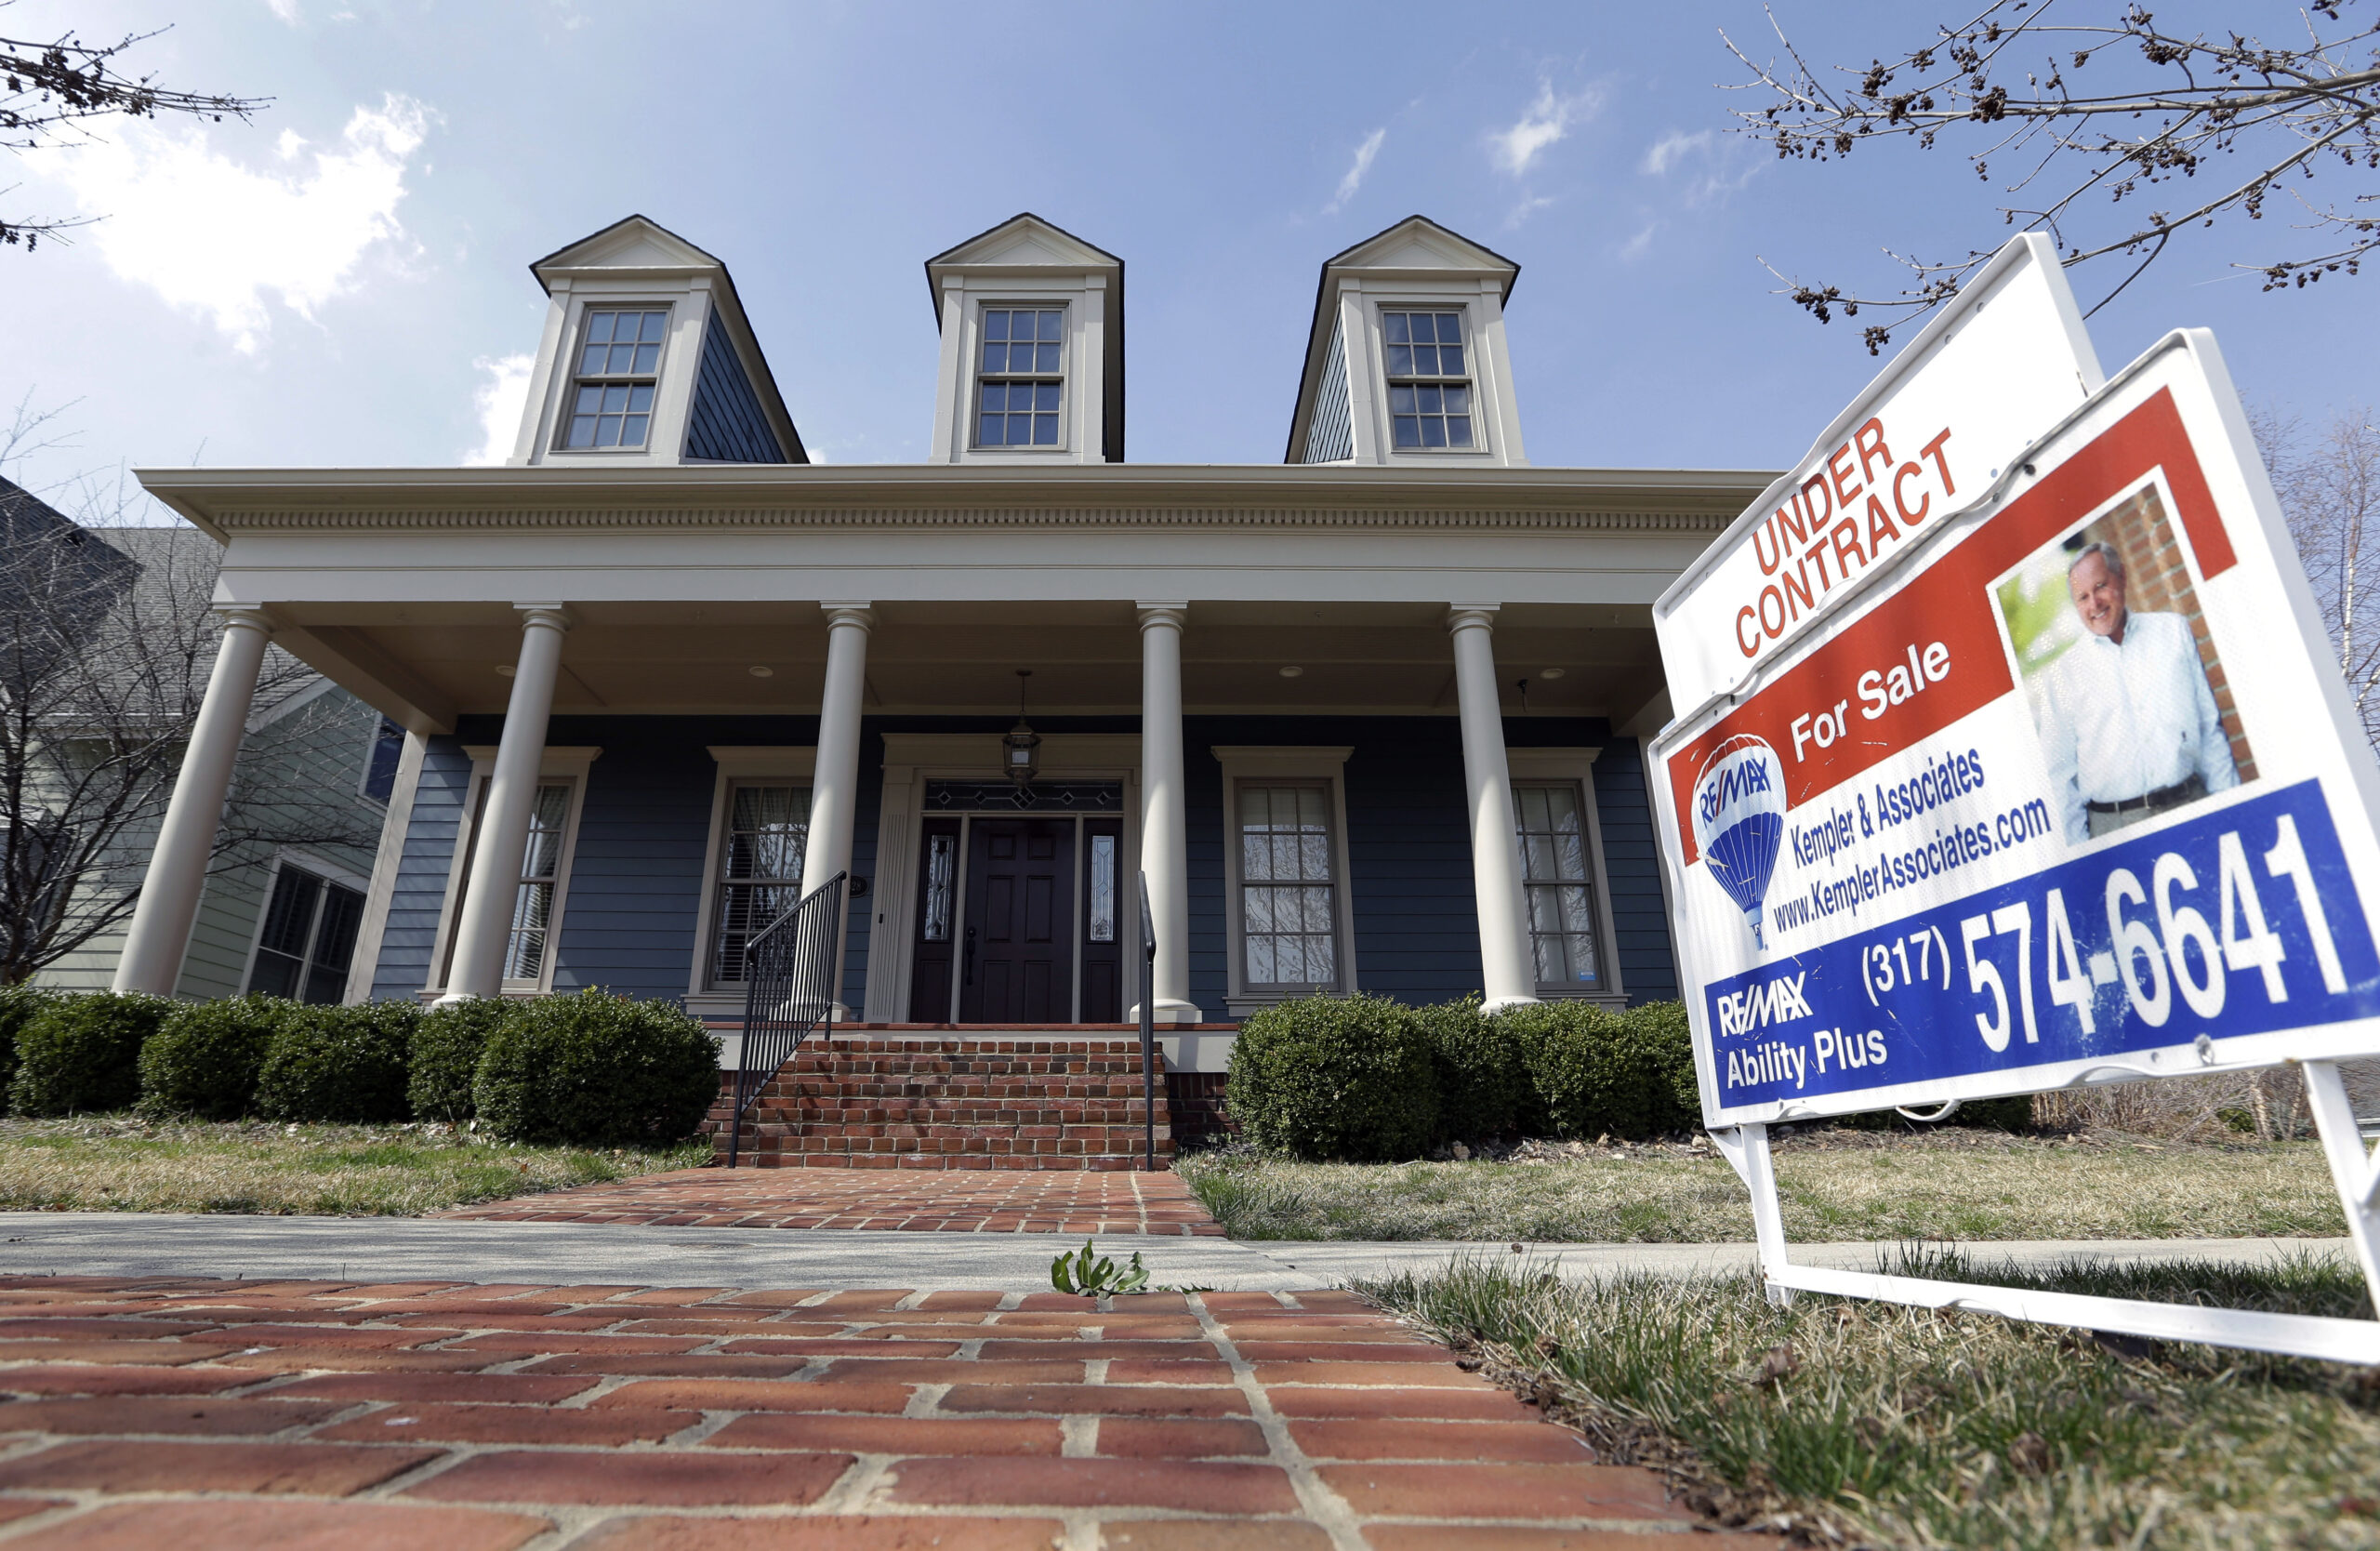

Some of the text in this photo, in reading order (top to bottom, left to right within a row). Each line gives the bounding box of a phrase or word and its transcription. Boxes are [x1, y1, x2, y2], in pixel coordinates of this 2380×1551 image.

[1736, 427, 1956, 658] CONTRACT
[1752, 418, 1895, 577] UNDER
[1791, 642, 1950, 762] For Sale
[1699, 757, 1771, 829] RE/MAX
[1791, 749, 1984, 868] Kempler & Associates
[1774, 798, 2051, 934] www.KemplerAssociates.com
[1862, 814, 2347, 1054] (317) 574-6641
[1717, 971, 1814, 1038] RE/MAX
[1726, 1027, 1887, 1090] Ability Plus
